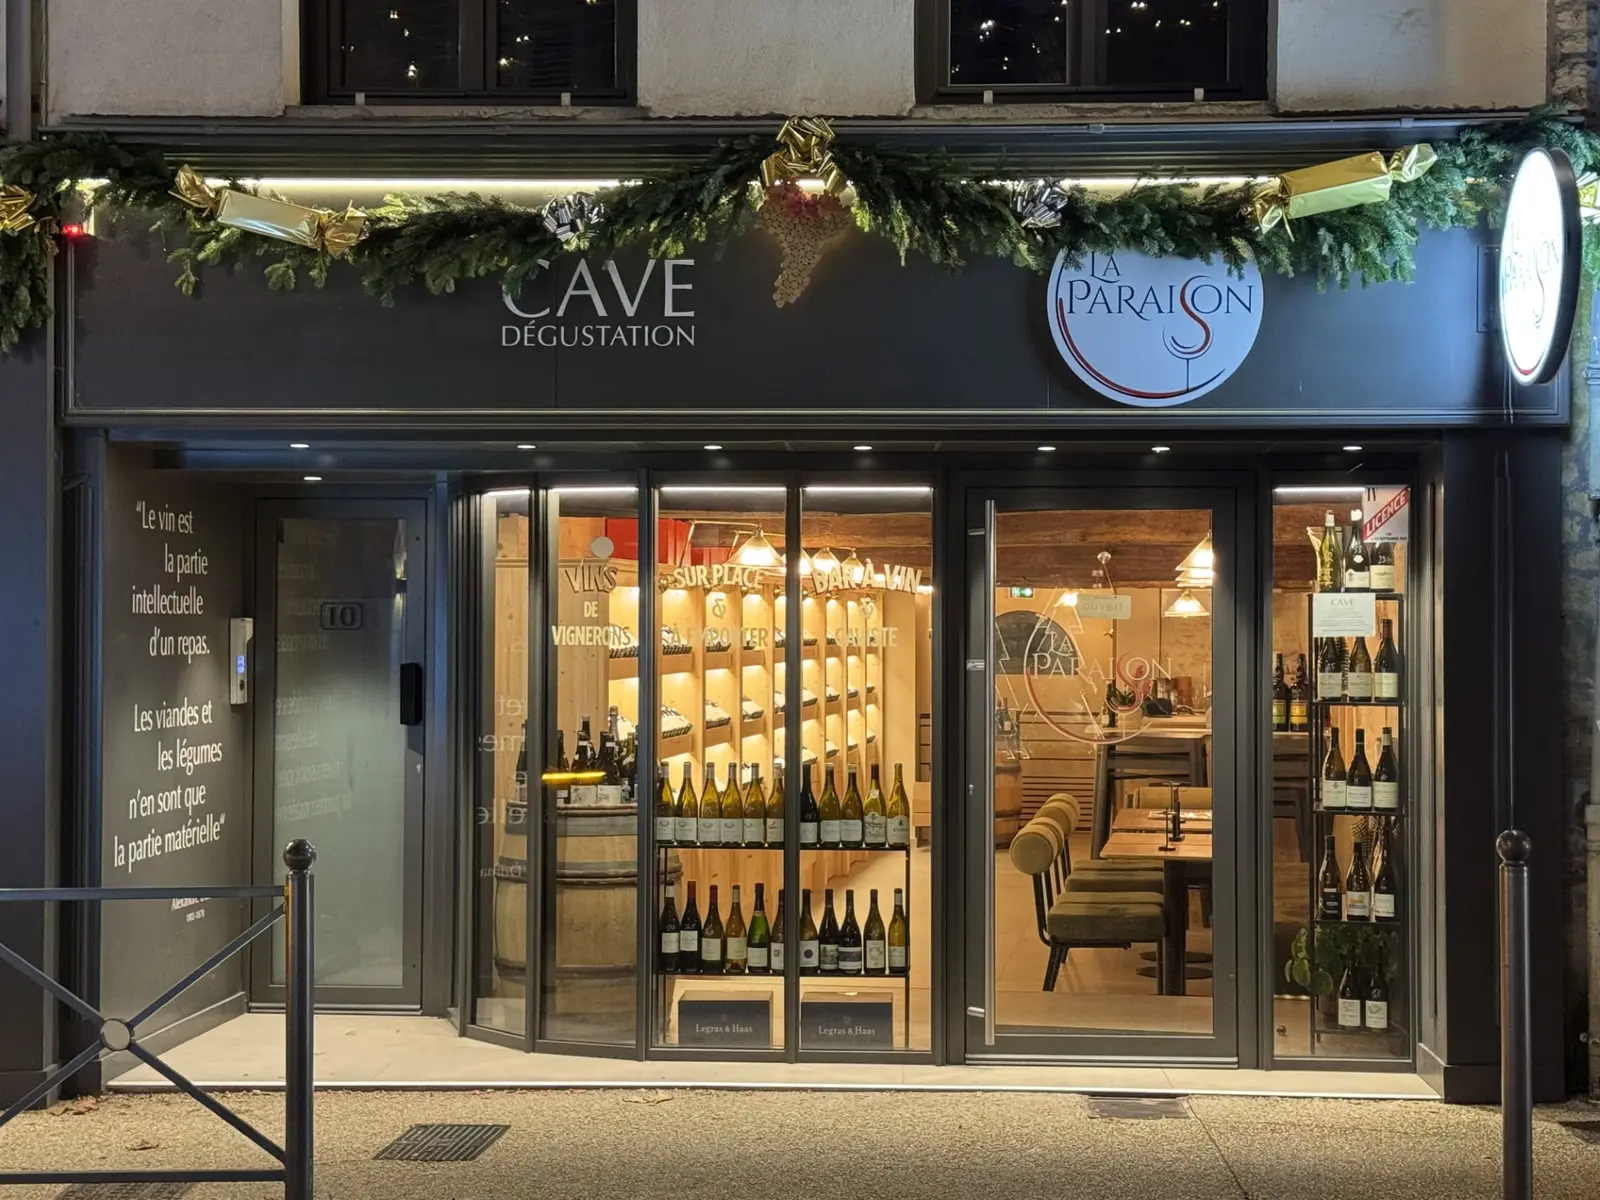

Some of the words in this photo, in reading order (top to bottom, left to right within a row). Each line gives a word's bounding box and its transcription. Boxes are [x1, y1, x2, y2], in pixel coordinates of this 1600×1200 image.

[1090, 251, 1121, 284] LA
[502, 257, 695, 318] CAVE
[1066, 275, 1255, 346] PARAISON
[501, 319, 695, 347] DÉGUSTATION
[158, 504, 175, 532] vin
[178, 511, 194, 534] est
[1365, 490, 1407, 538] LICENCE
[164, 543, 174, 573] la
[177, 548, 208, 583] partie
[673, 565, 712, 589] SUR
[712, 563, 765, 590] PLACE
[564, 564, 620, 594] VINS
[812, 566, 857, 595] BAR
[884, 563, 923, 595] VIN
[132, 584, 204, 615] intellectuelle
[583, 601, 599, 618] DE
[329, 605, 356, 627] 10
[178, 634, 210, 665] repas.
[551, 625, 631, 647] VIGNERONS
[1046, 631, 1075, 657] LA
[1031, 652, 1173, 700] PARAISON
[134, 703, 153, 732] Les
[156, 697, 199, 730] viandes
[202, 700, 213, 725] et
[158, 741, 173, 771] les
[176, 738, 223, 776] légumes
[157, 784, 182, 814] sont
[185, 784, 207, 816] que
[114, 836, 125, 867] la
[128, 828, 162, 873] partie
[695, 1023, 723, 1034] Legras
[732, 1023, 753, 1033] Haas
[818, 1026, 846, 1036] Legras
[855, 1026, 876, 1035] Haas
